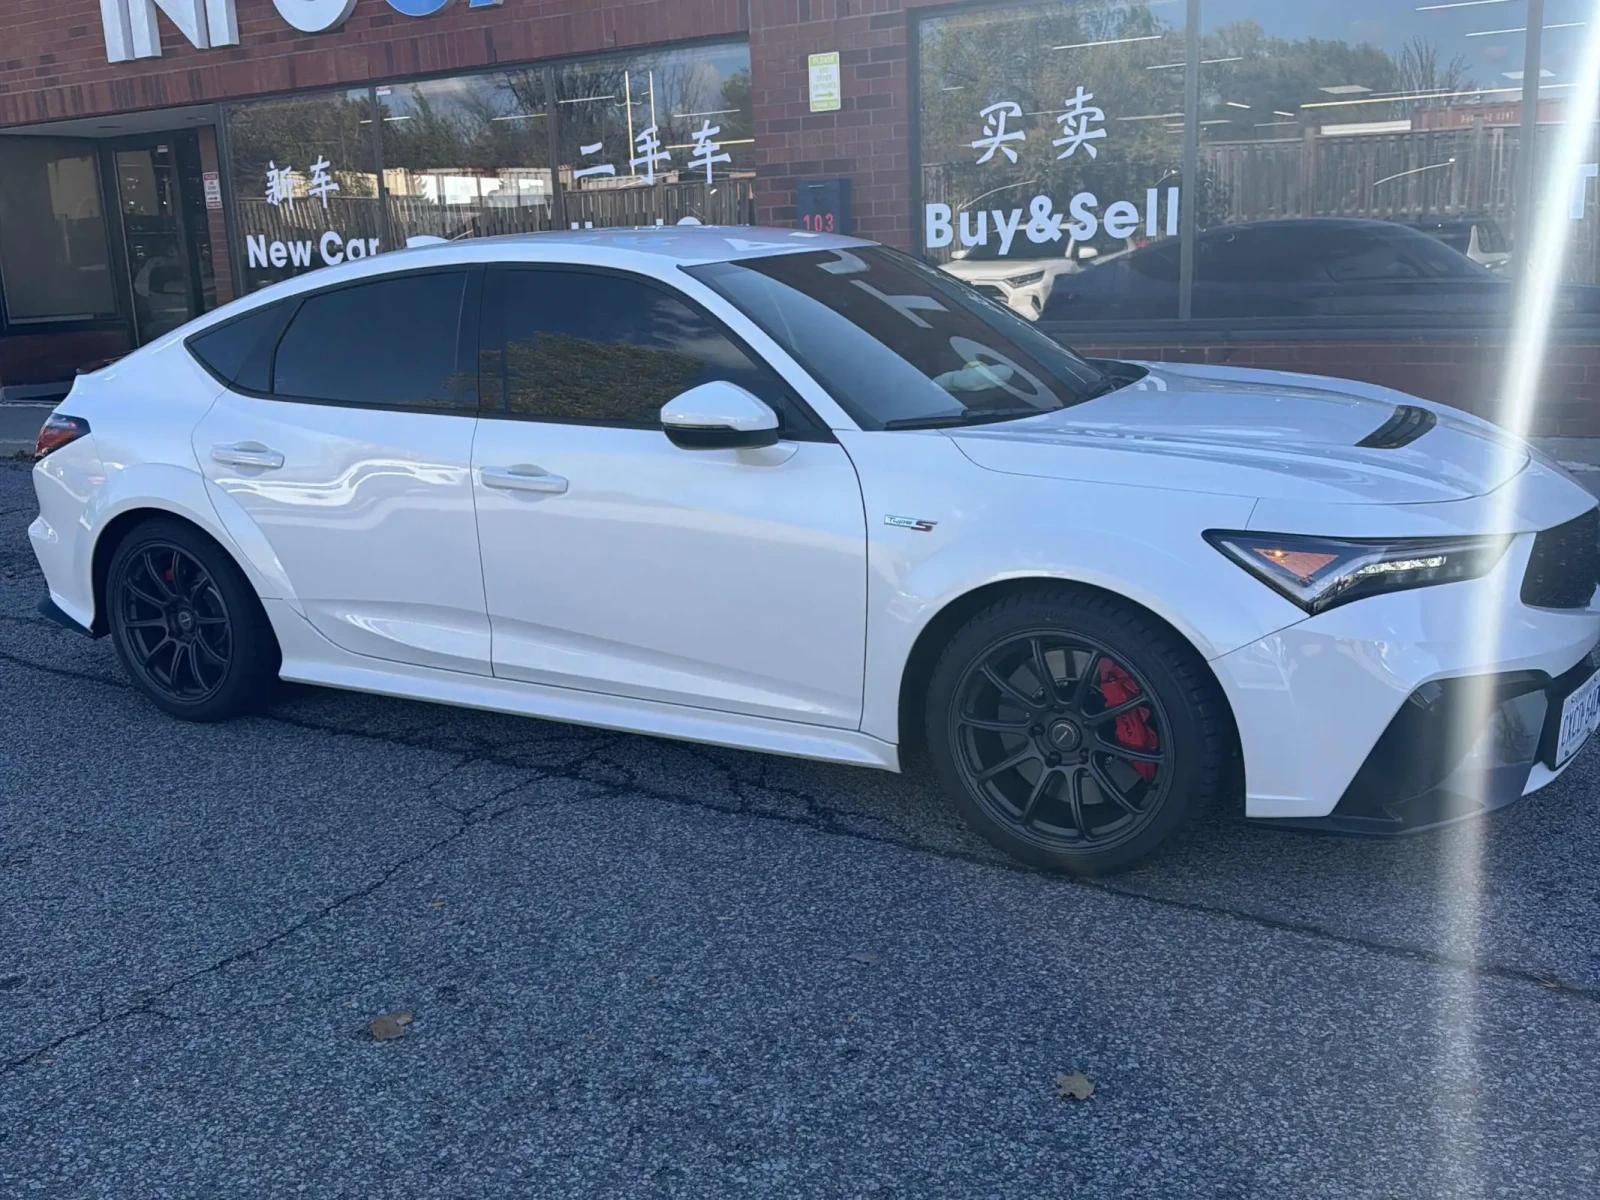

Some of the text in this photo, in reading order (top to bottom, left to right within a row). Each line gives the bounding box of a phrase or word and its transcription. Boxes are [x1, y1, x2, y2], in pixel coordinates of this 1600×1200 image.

[573, 119, 732, 186] 二手车
[971, 86, 1107, 165] 买卖
[265, 155, 340, 211] 新车
[246, 234, 312, 268] New
[320, 231, 380, 266] Car
[803, 213, 834, 234] 103
[925, 187, 1179, 256] Buy&Sell
[911, 520, 938, 532] S
